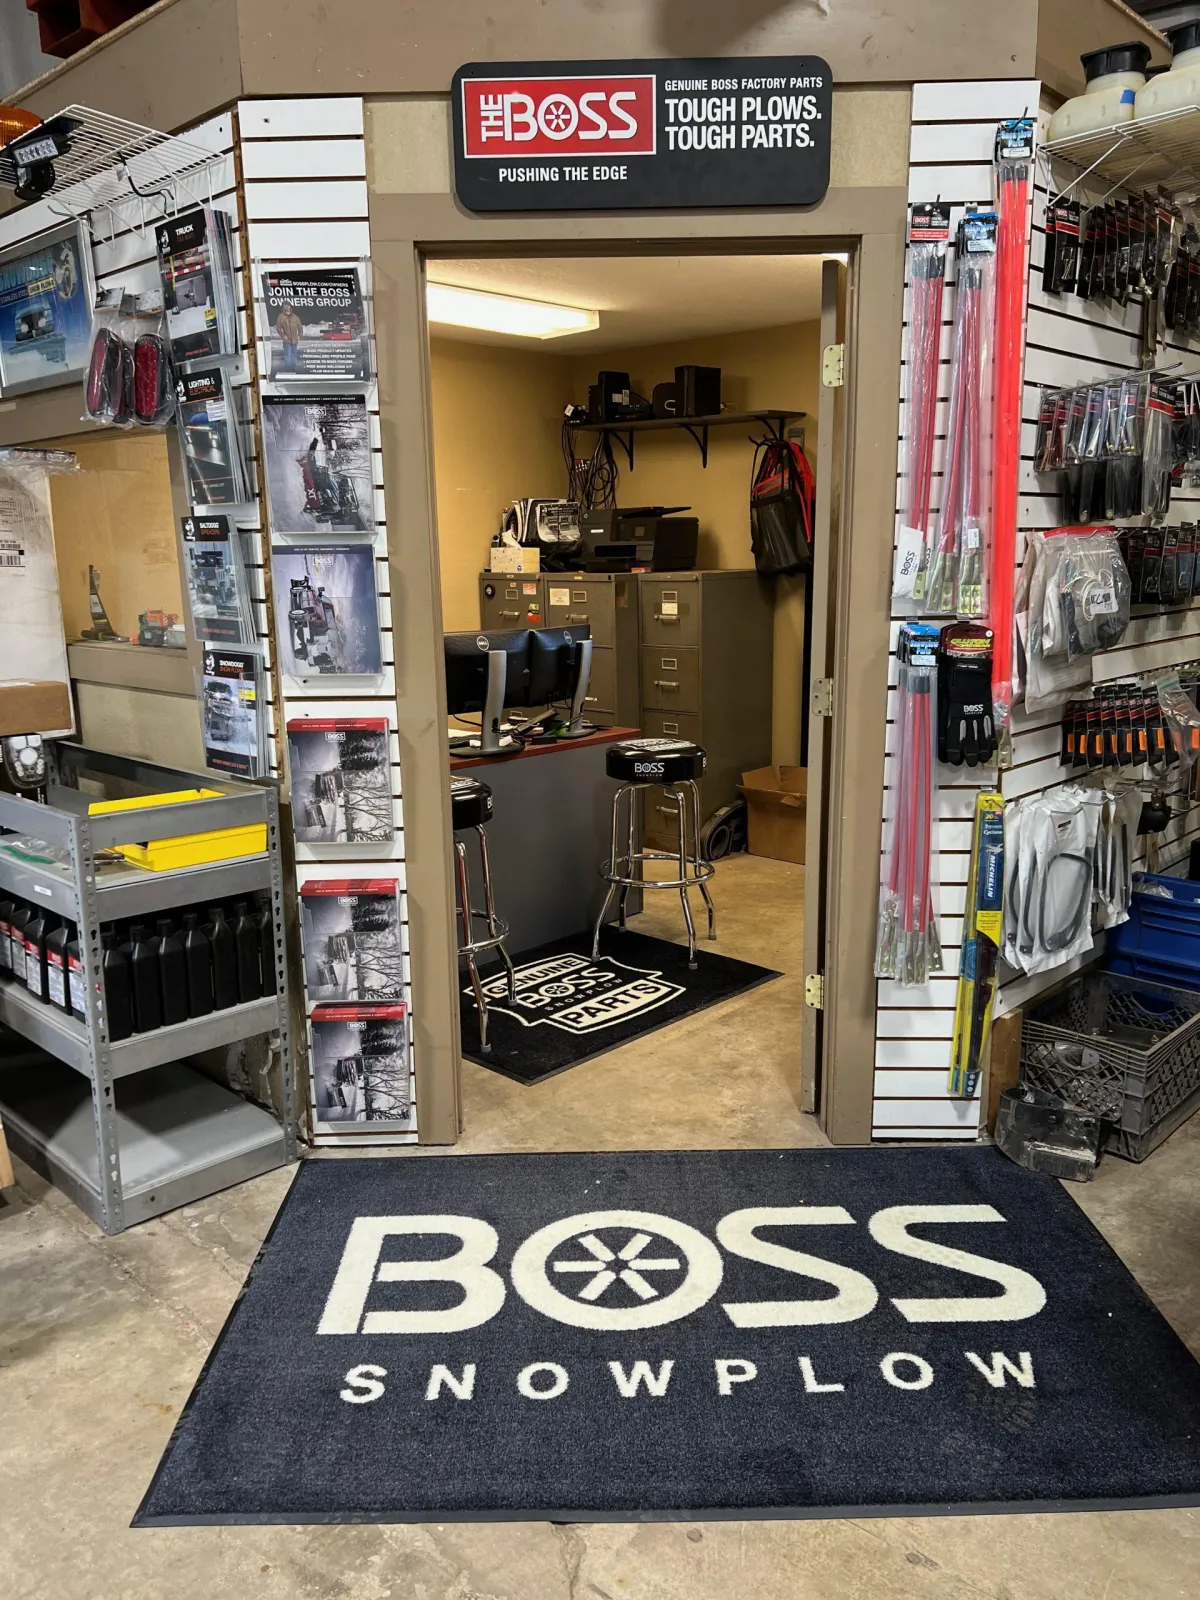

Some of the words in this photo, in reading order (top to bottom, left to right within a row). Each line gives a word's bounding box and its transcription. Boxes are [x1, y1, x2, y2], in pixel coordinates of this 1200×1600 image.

[664, 78, 708, 91] GENUINE
[711, 77, 739, 91] BOSS
[741, 77, 787, 90] FACTORY
[789, 76, 823, 89] PARTS
[480, 94, 503, 142] THE
[504, 91, 638, 142] BOSS
[665, 97, 737, 123] TOUGH
[741, 94, 822, 121] PLOWS.
[665, 125, 737, 151] TOUGH
[741, 123, 815, 149] PARTS.
[498, 167, 560, 182] PUSHING
[562, 166, 589, 181] THE
[593, 165, 628, 181] EDGE
[175, 224, 194, 236] TRUCK
[268, 287, 294, 296] JOIN
[296, 287, 318, 296] THE
[320, 288, 350, 297] BOSS
[270, 297, 314, 307] OWNERS
[316, 298, 352, 307] GROUP
[188, 378, 210, 388] LIGHTING
[900, 551, 915, 575] BOSS
[963, 704, 984, 712] BOSS
[634, 762, 665, 773] BOSS
[987, 855, 996, 898] MICHELIN
[516, 967, 616, 1009] BOSS
[545, 978, 623, 1011] SNOWPLOW
[561, 981, 662, 1025] PARTS
[315, 1204, 1048, 1336] BOSS
[339, 1350, 1038, 1405] SNOWPLOW
